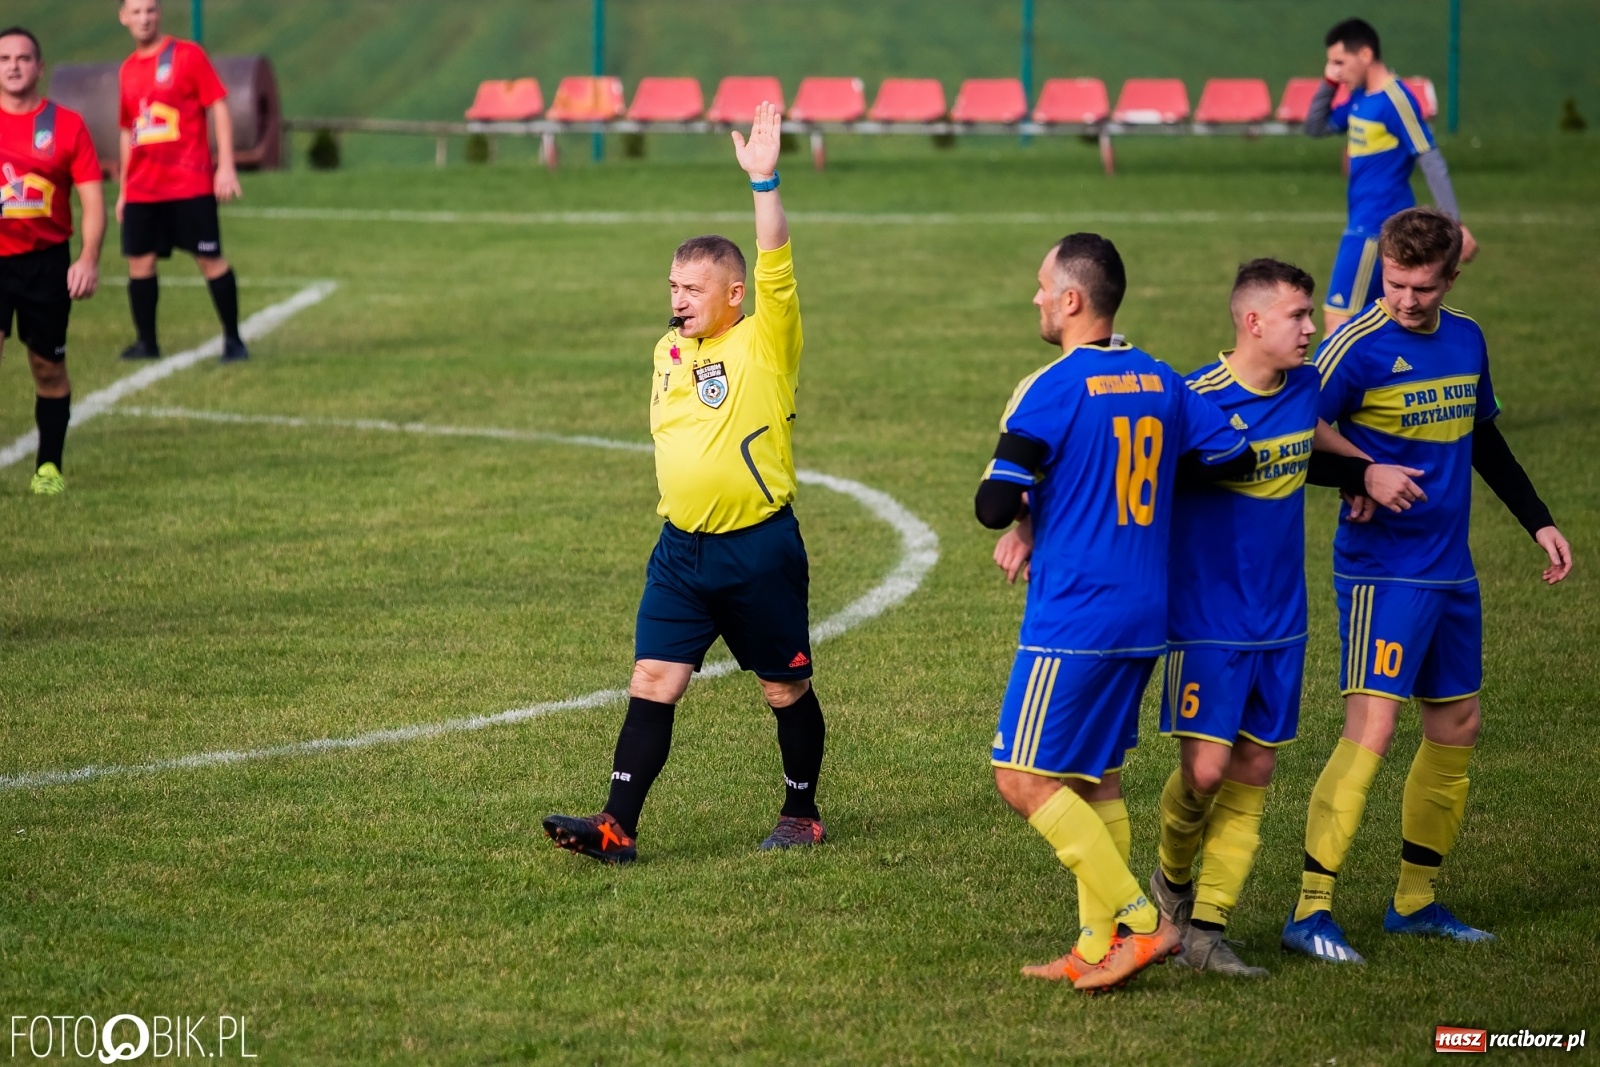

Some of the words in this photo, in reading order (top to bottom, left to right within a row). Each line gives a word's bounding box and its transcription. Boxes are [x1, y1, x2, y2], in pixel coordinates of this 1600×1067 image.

[1404, 388, 1438, 408] PRD
[1112, 416, 1163, 526] 18
[1373, 639, 1403, 678] 10
[1180, 682, 1200, 719] 6
[611, 771, 631, 782] na
